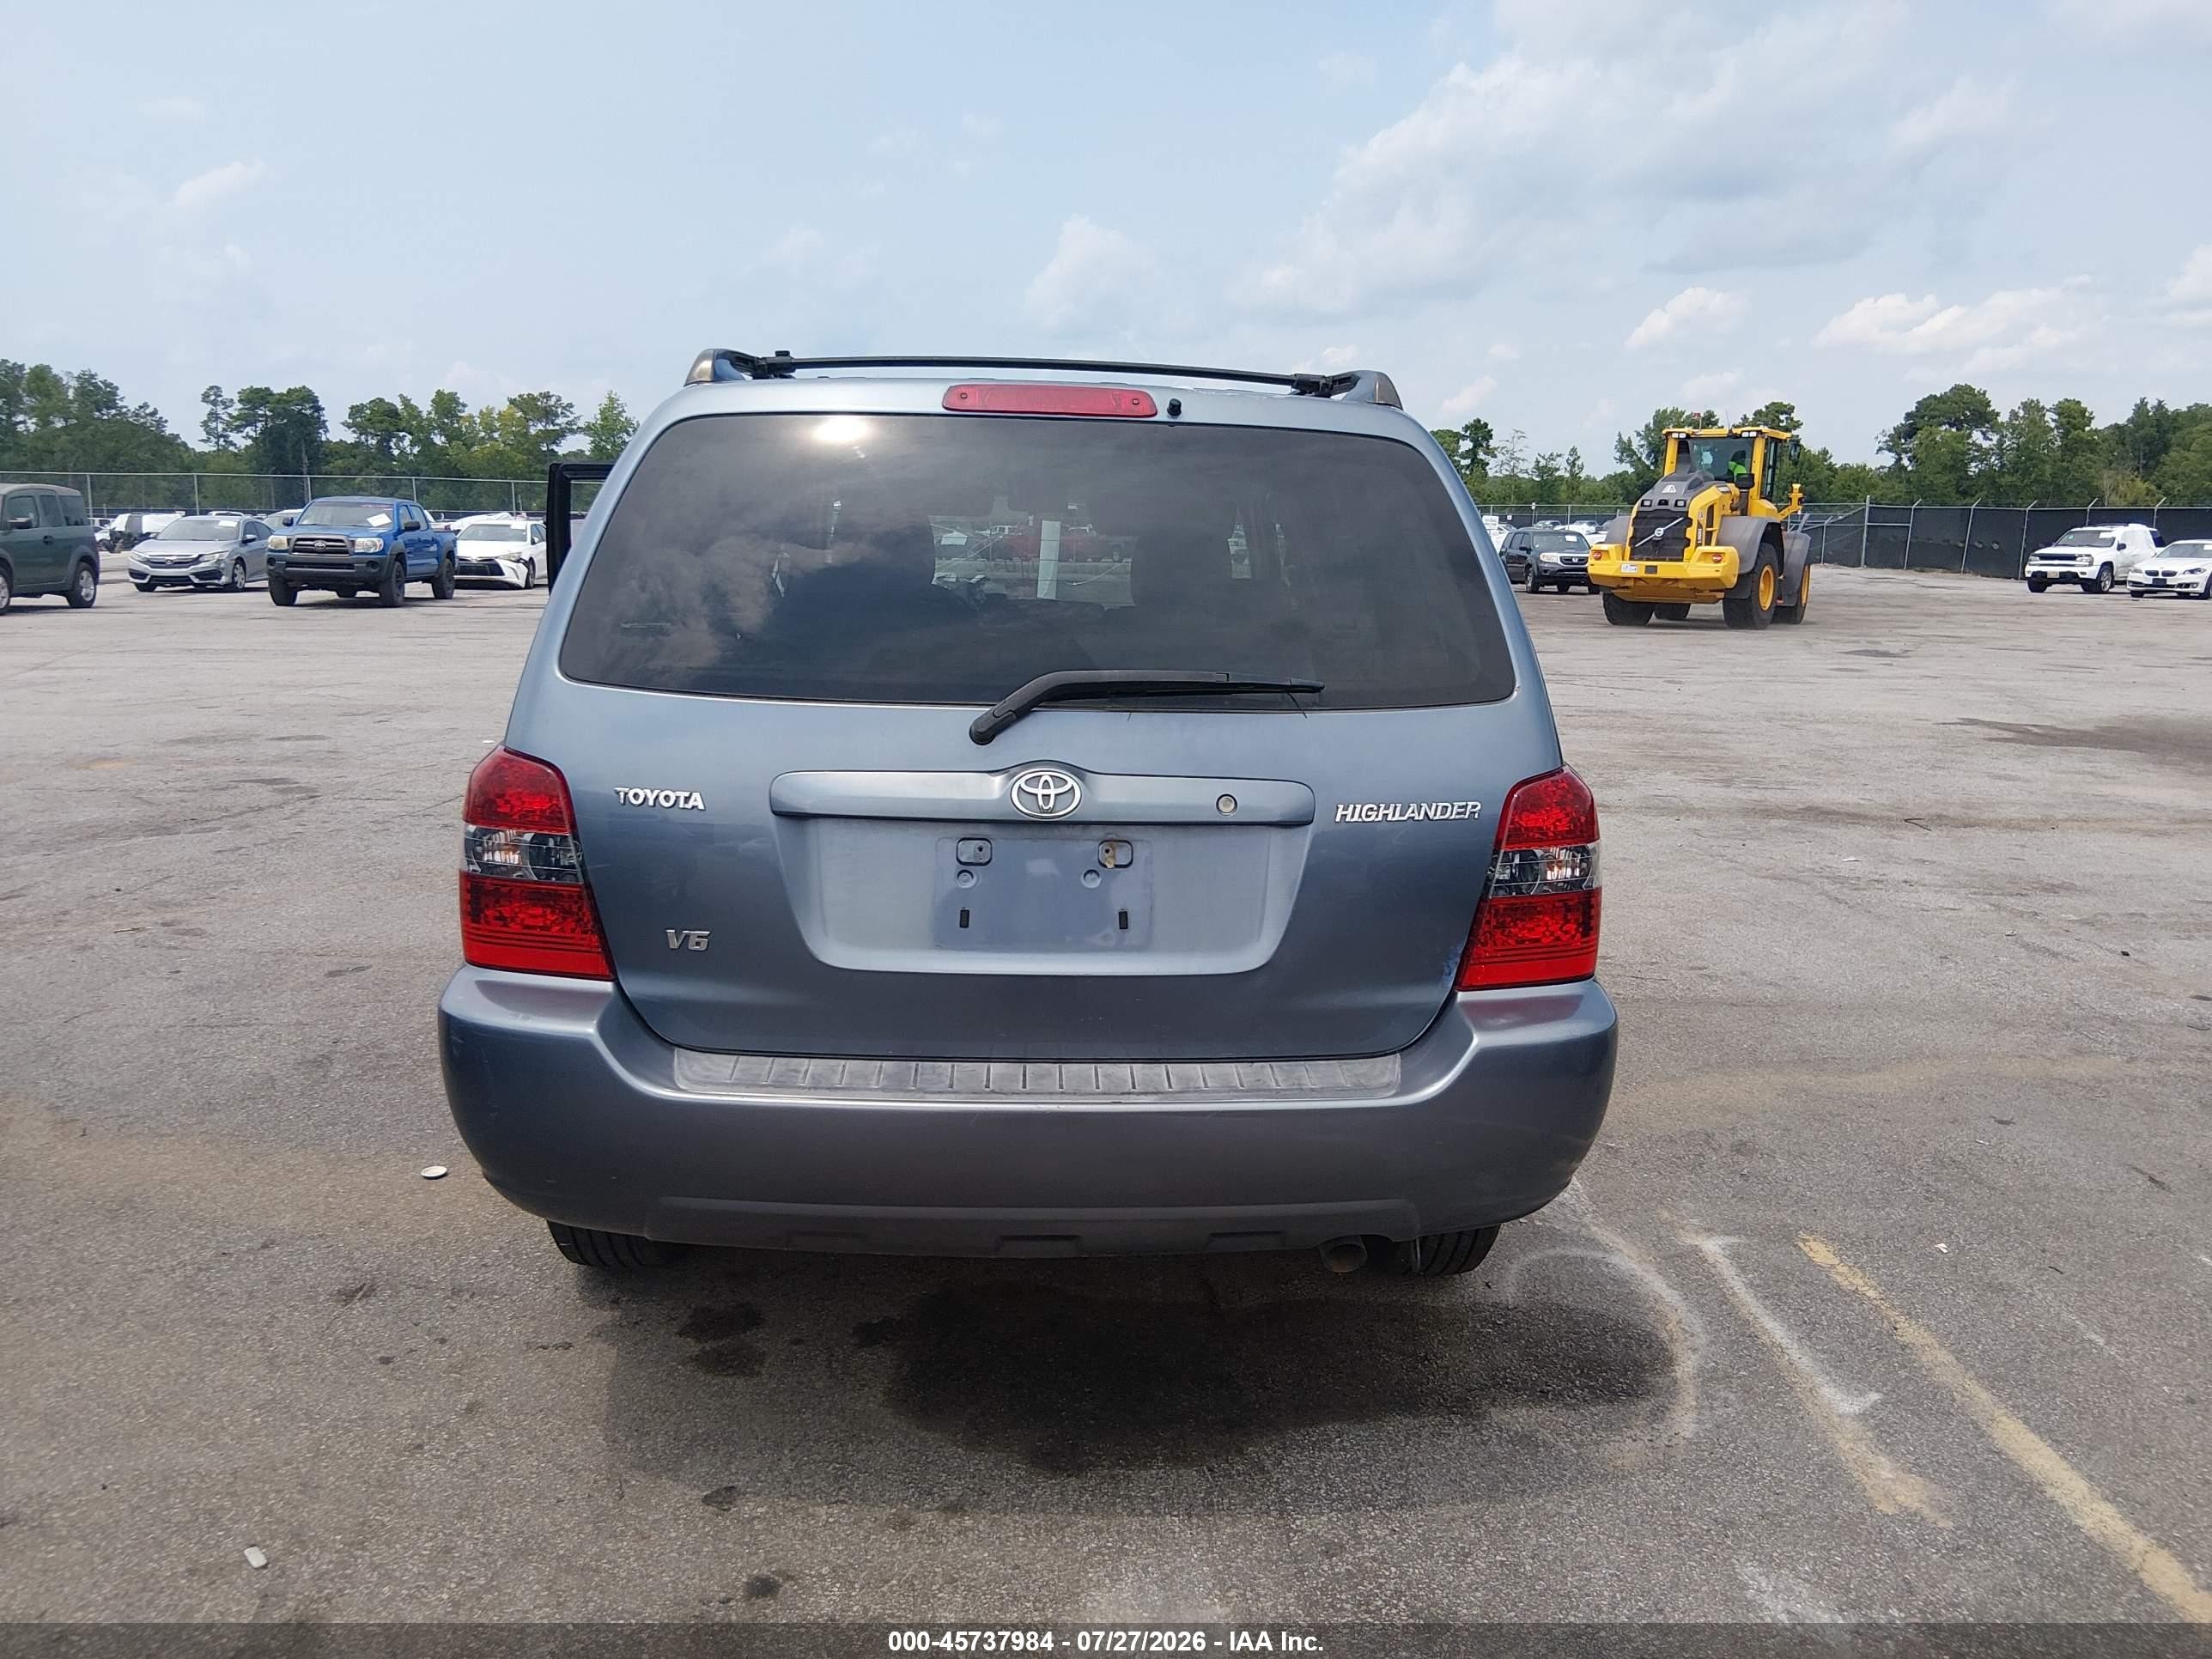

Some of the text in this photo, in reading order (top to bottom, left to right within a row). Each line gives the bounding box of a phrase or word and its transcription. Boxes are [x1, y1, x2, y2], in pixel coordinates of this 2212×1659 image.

[614, 787, 706, 811] TOYOTA
[1334, 801, 1481, 823] HIGHLANDER
[665, 929, 711, 951] V6
